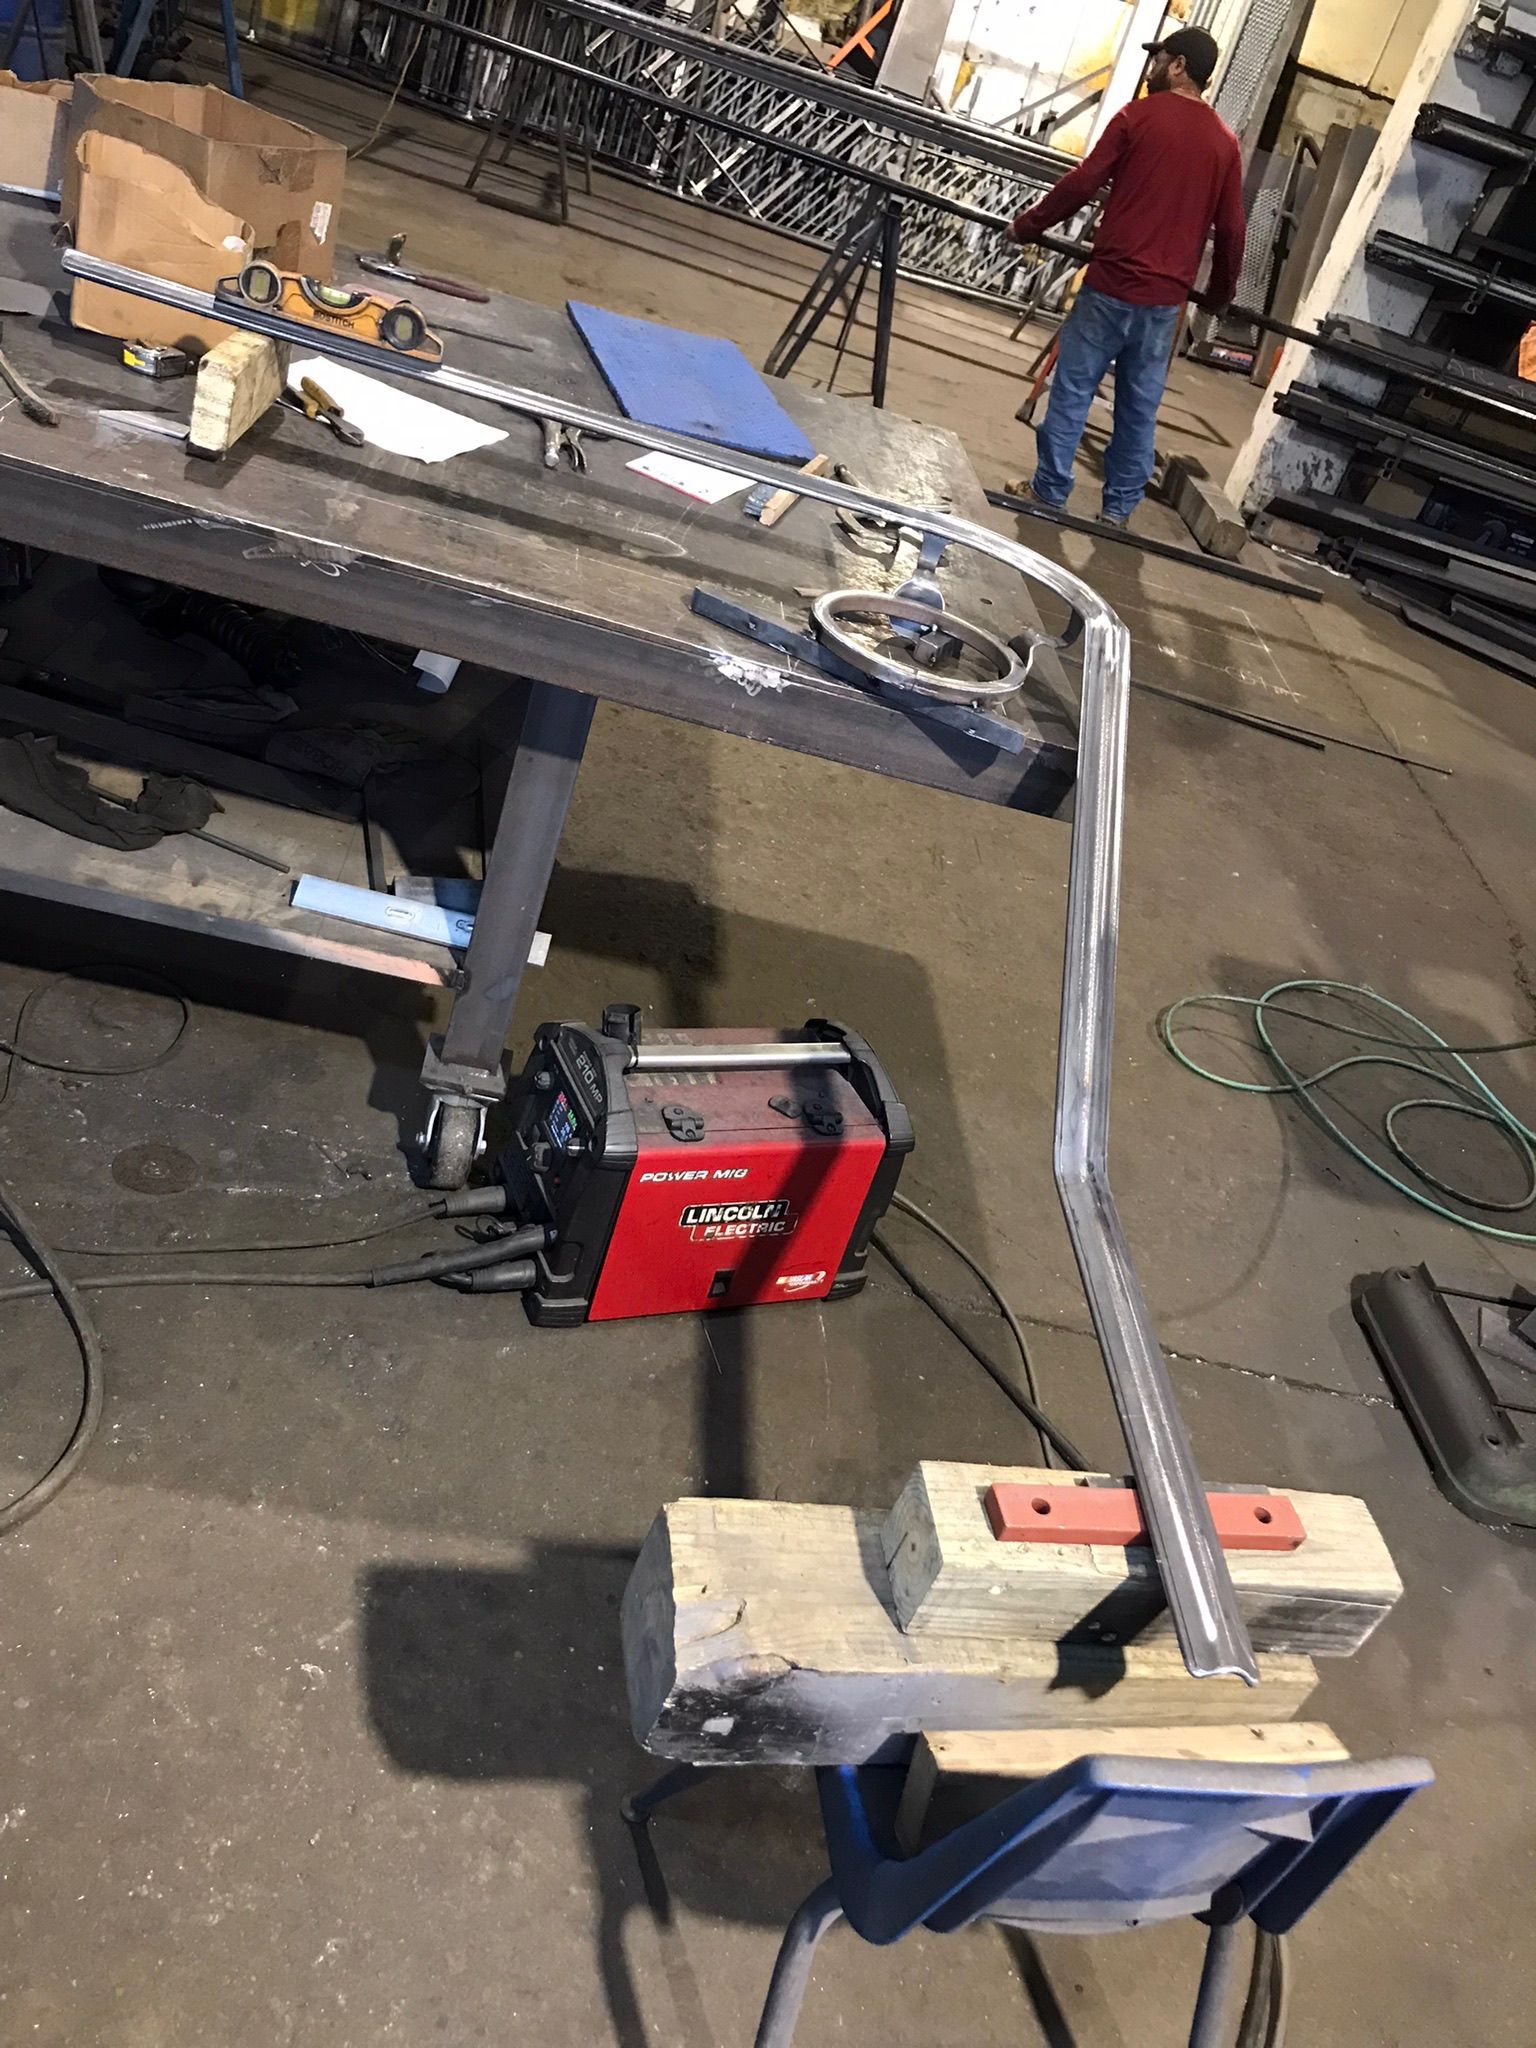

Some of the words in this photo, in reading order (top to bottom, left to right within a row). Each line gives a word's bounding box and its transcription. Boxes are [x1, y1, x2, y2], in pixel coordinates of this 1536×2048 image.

[575, 1053, 595, 1084] 210
[589, 1083, 603, 1103] MP
[639, 1170, 709, 1183] POWER
[713, 1168, 749, 1180] MIG
[686, 1203, 782, 1224] LINCOLN
[703, 1221, 786, 1237] ELECTRIC
